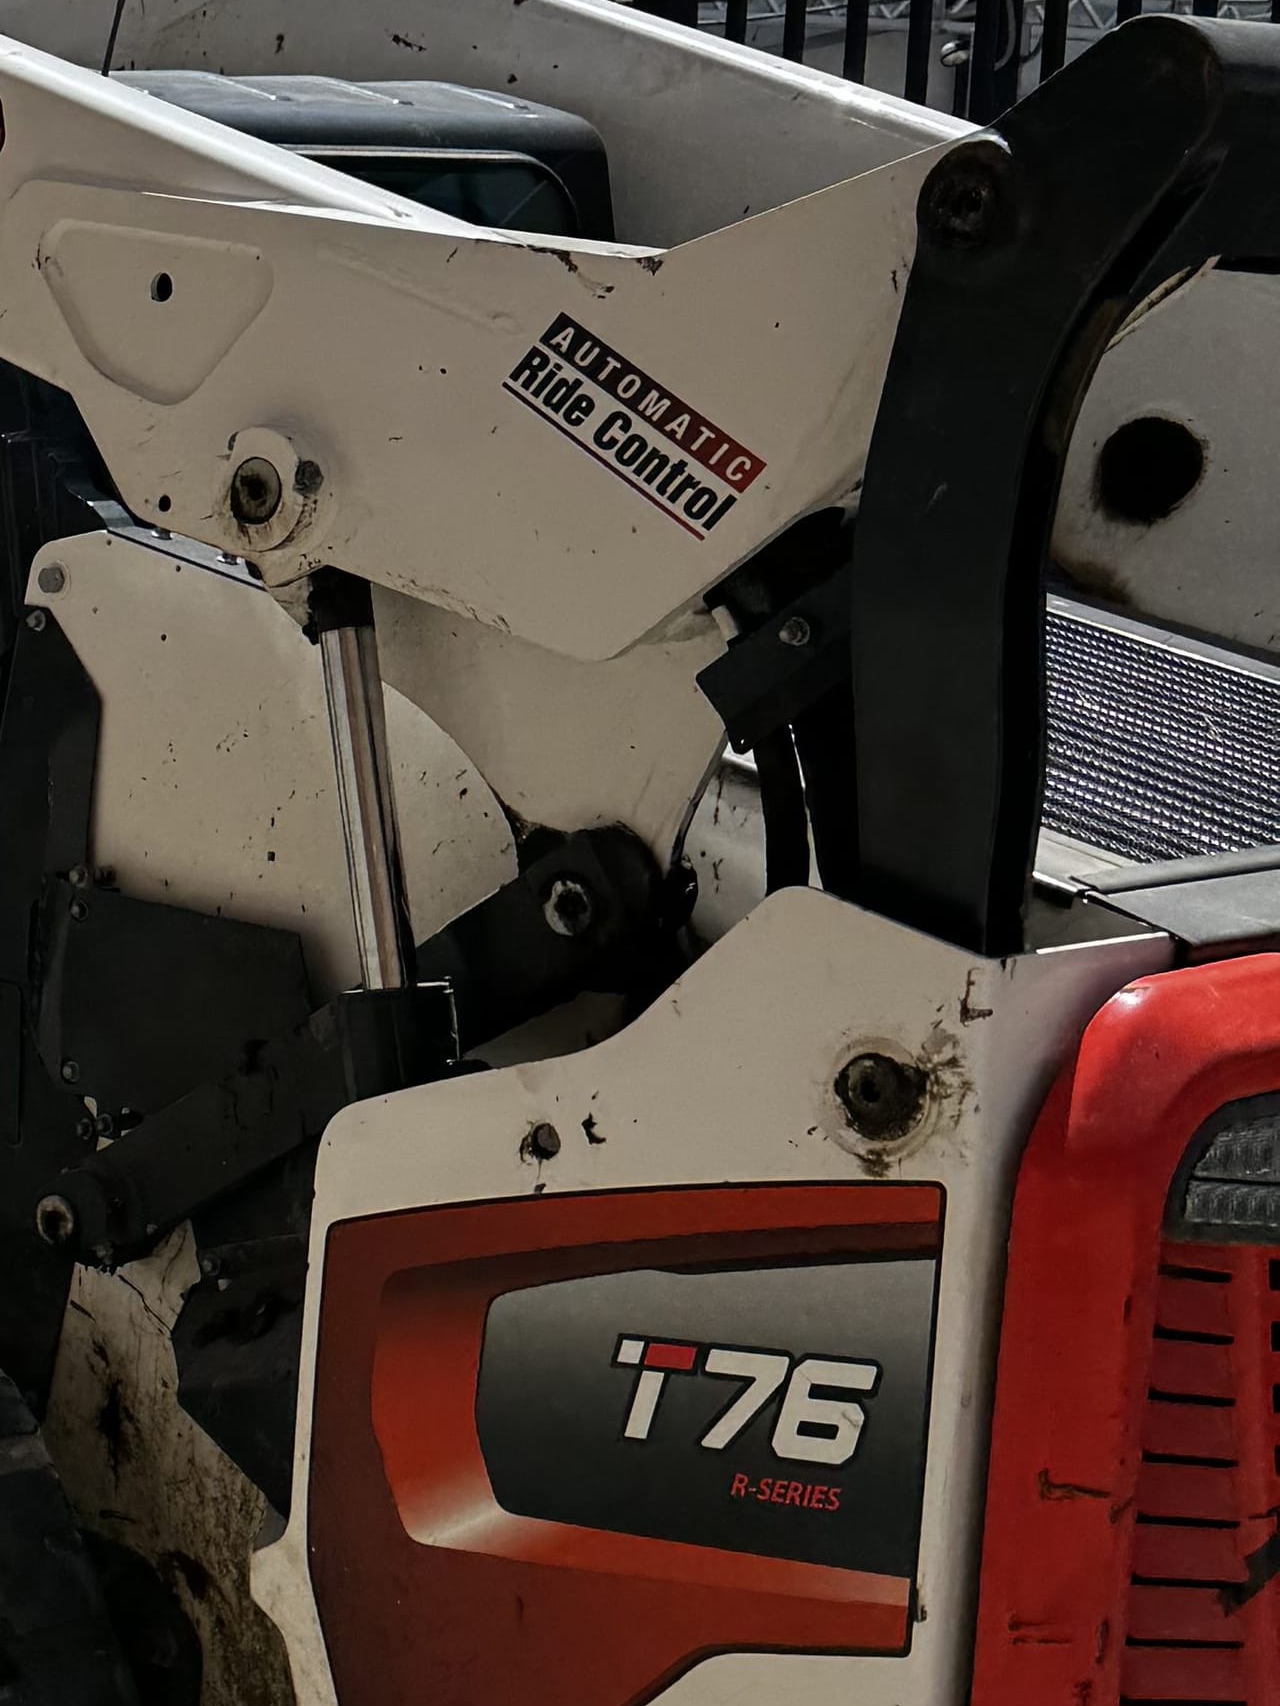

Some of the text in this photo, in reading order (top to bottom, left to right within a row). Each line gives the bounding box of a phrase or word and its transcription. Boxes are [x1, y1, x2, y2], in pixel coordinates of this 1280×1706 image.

[508, 345, 738, 532] Ride Control
[549, 326, 752, 482] AUTOMATIC
[614, 1337, 880, 1466] T76
[730, 1473, 842, 1511] R-SERIES
